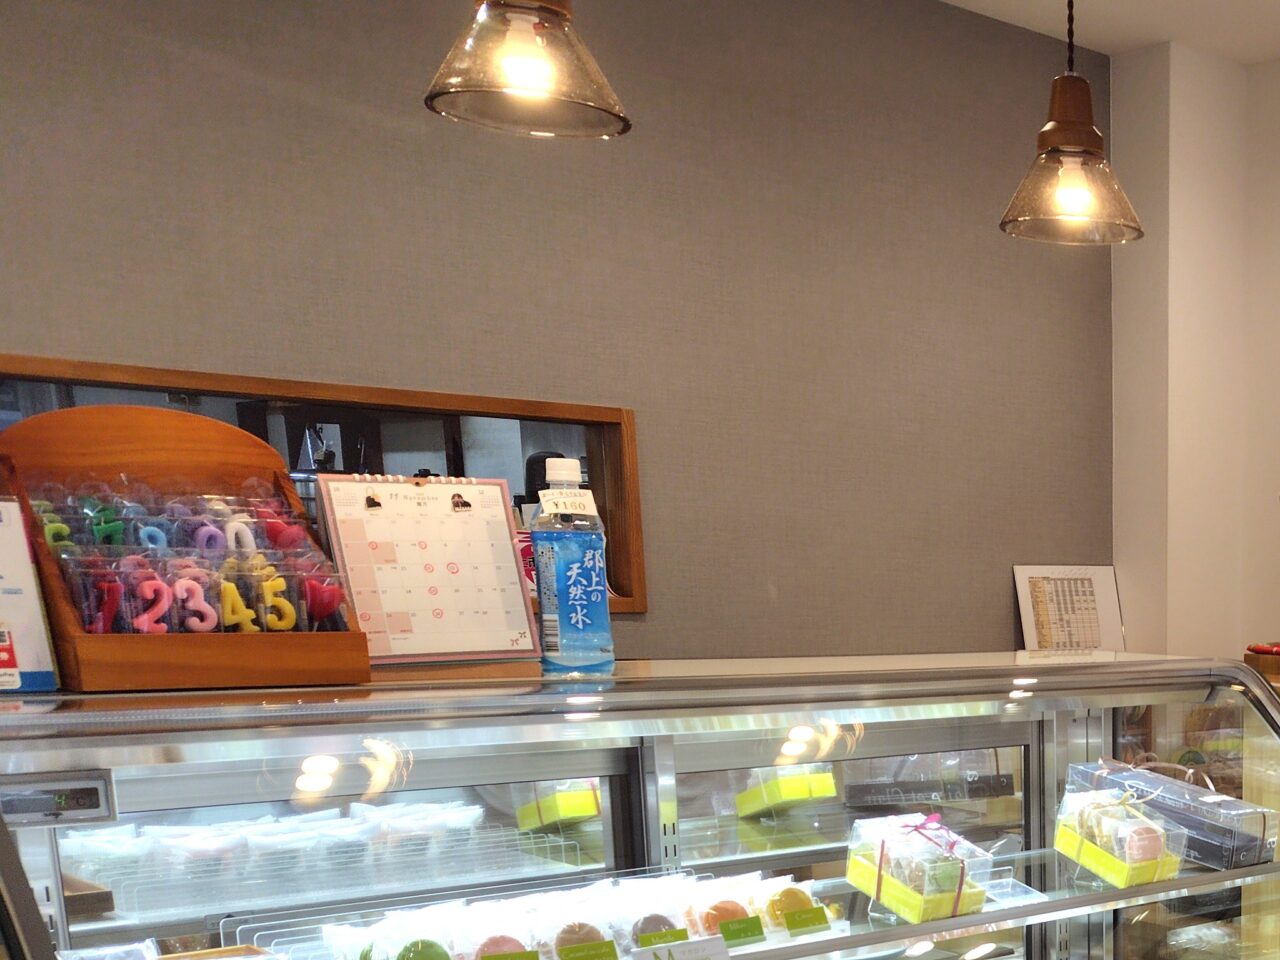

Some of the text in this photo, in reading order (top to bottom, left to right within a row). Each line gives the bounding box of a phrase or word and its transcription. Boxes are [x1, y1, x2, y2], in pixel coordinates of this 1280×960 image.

[566, 562, 592, 630] 天然水
[583, 549, 604, 603] 郡上の
